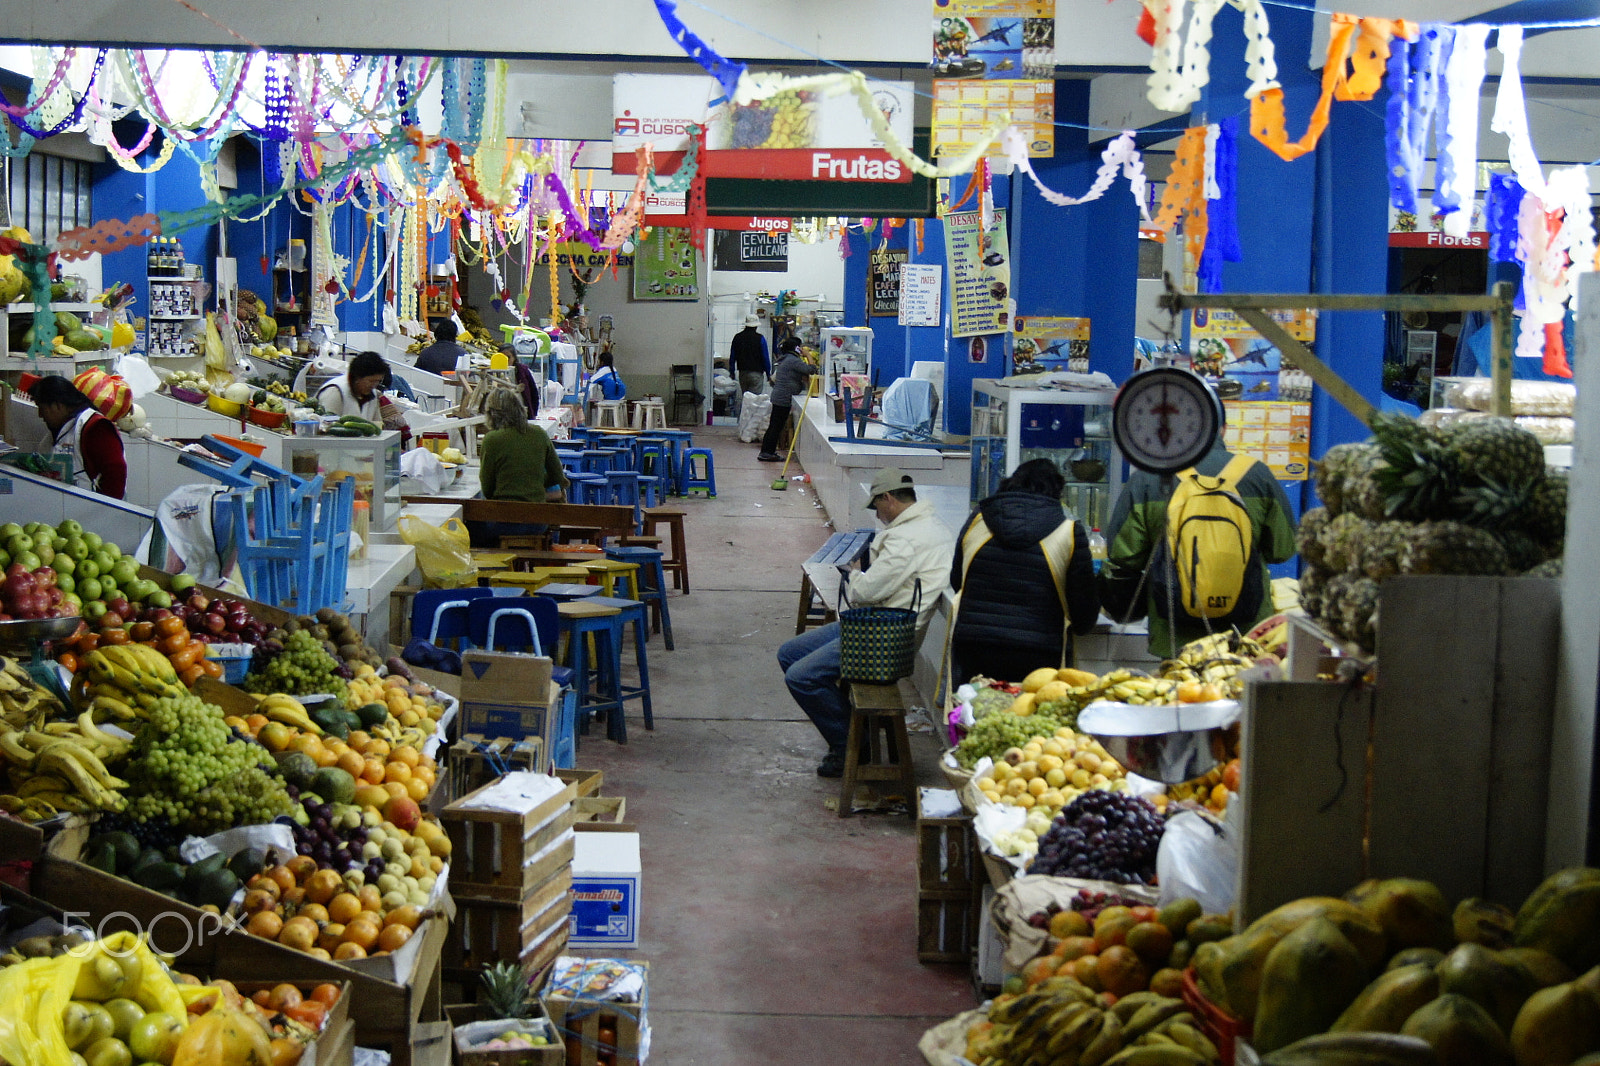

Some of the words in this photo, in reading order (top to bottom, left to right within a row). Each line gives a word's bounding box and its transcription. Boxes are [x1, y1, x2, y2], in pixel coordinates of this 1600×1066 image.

[642, 124, 690, 135] CUSC
[812, 153, 901, 180] Frutas
[749, 216, 789, 231] Jugos
[1427, 233, 1482, 246] Flores
[874, 281, 897, 290] CAFE
[921, 276, 936, 284] MATES
[1208, 596, 1228, 607] CAT
